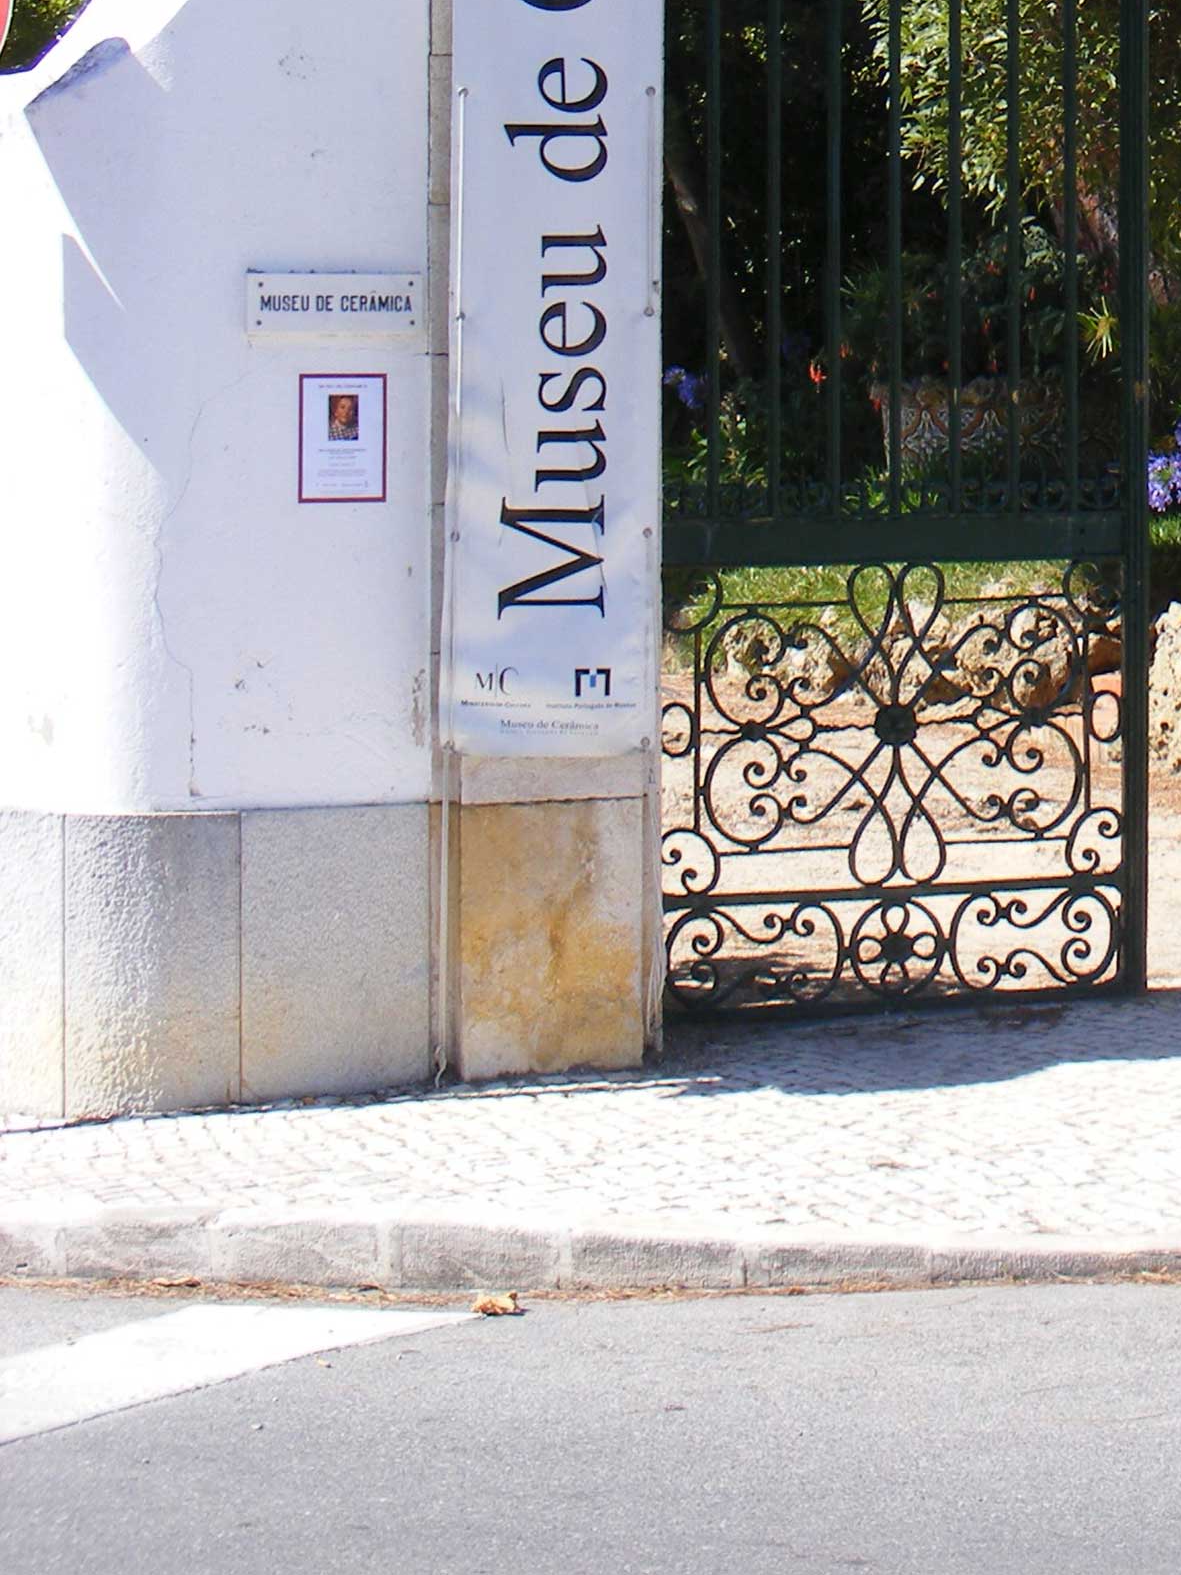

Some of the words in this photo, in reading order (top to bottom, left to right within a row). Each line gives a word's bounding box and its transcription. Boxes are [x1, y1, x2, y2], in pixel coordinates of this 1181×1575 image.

[503, 57, 607, 183] de
[259, 295, 310, 312] MUSEU
[316, 295, 334, 312] DE
[341, 290, 413, 312] CERÂMICA
[497, 224, 608, 620] Museu
[500, 719, 534, 729] Museu
[536, 719, 549, 729] de
[551, 719, 599, 730] Cerâmica
